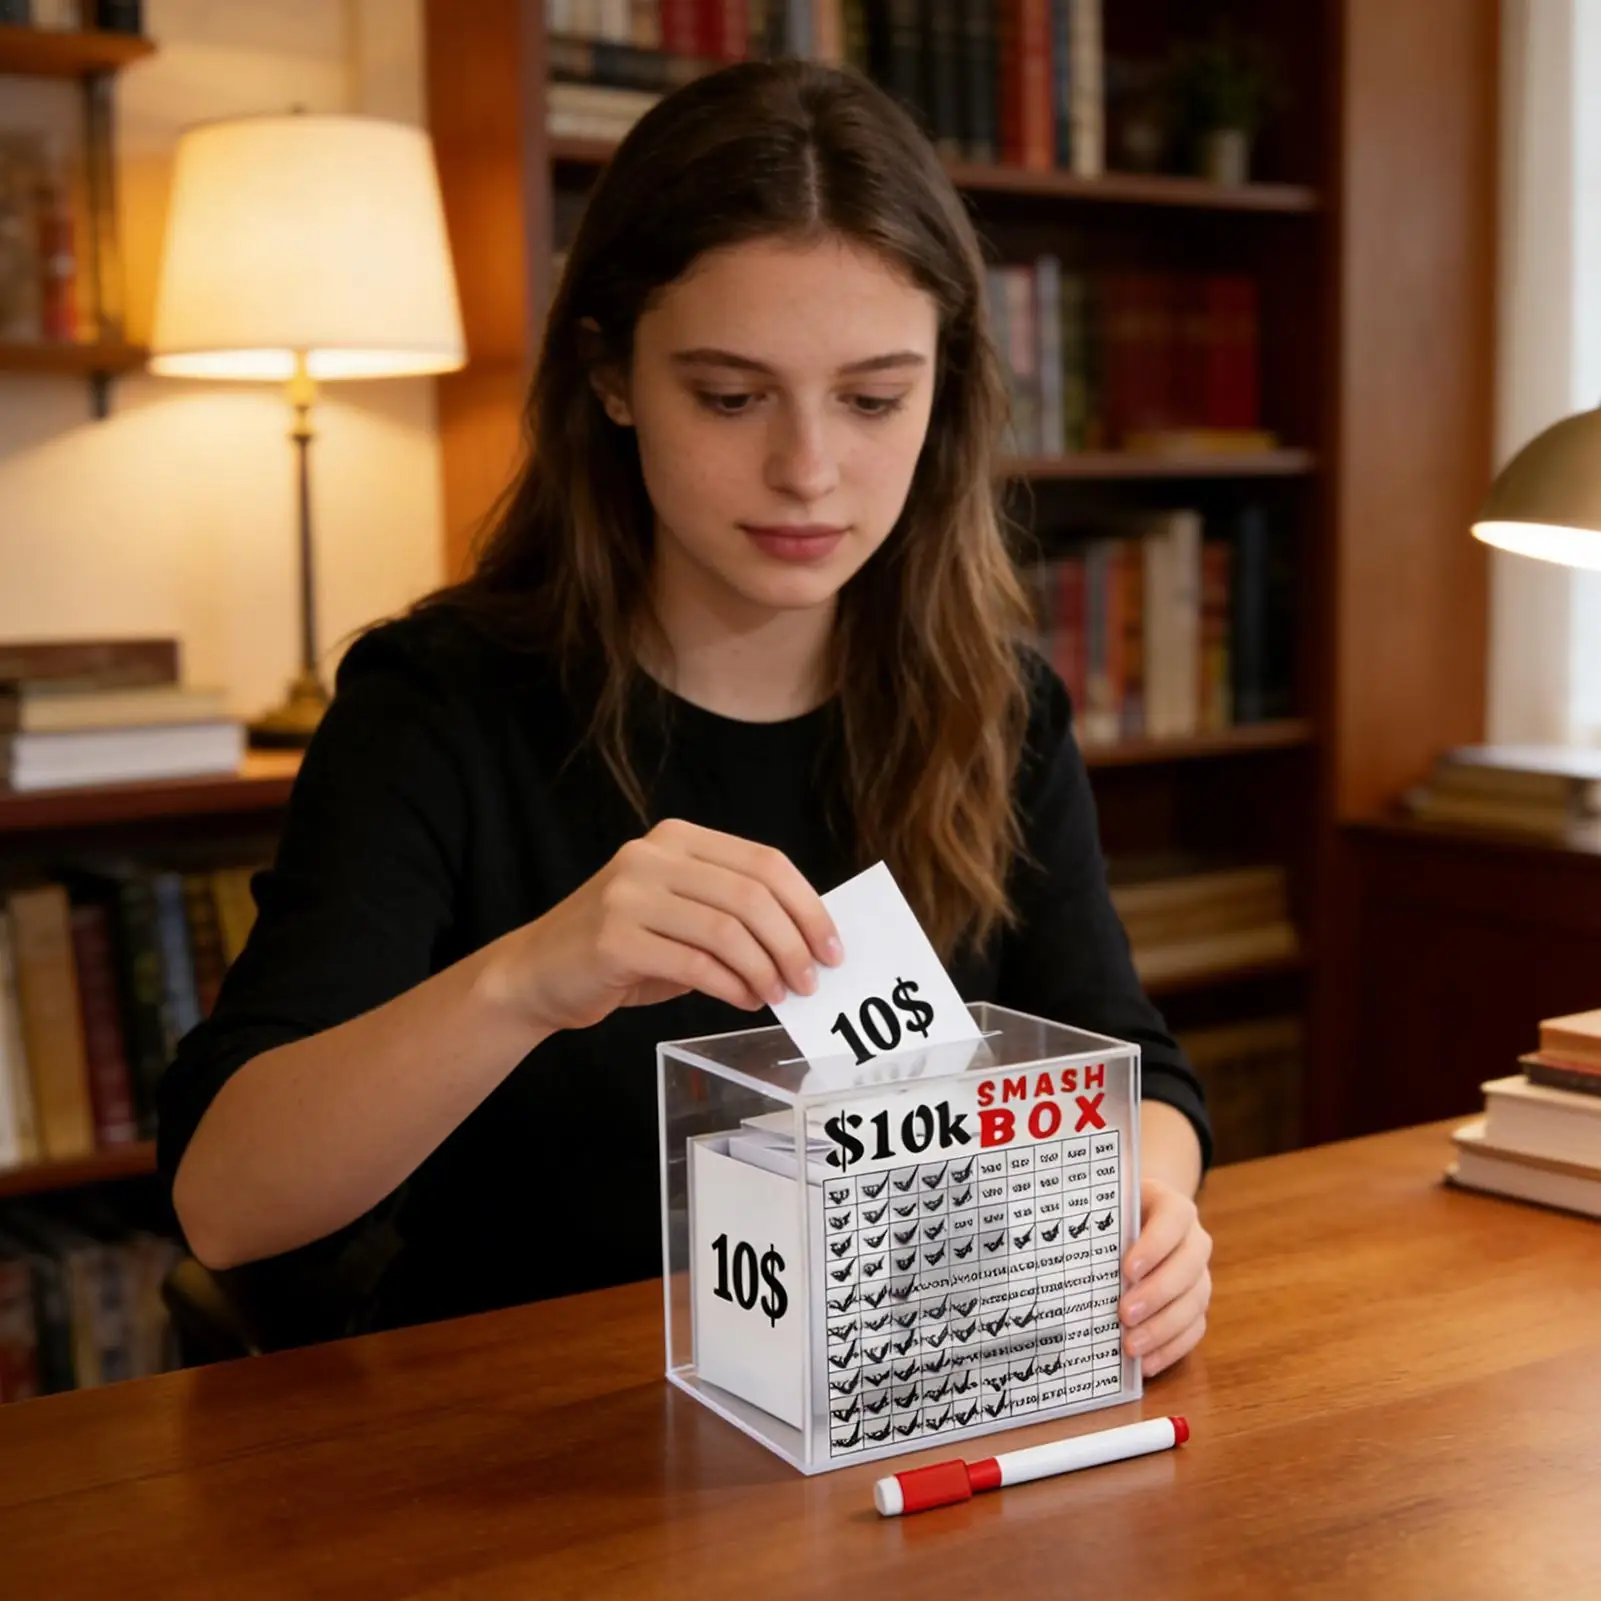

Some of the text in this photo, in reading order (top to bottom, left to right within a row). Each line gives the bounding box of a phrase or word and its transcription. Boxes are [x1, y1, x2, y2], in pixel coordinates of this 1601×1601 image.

[830, 977, 935, 1066] 10$
[977, 1063, 1106, 1107] SMASH
[978, 1092, 1106, 1149] BOX
[824, 1100, 972, 1173] $10k
[711, 1233, 789, 1329] 10$
